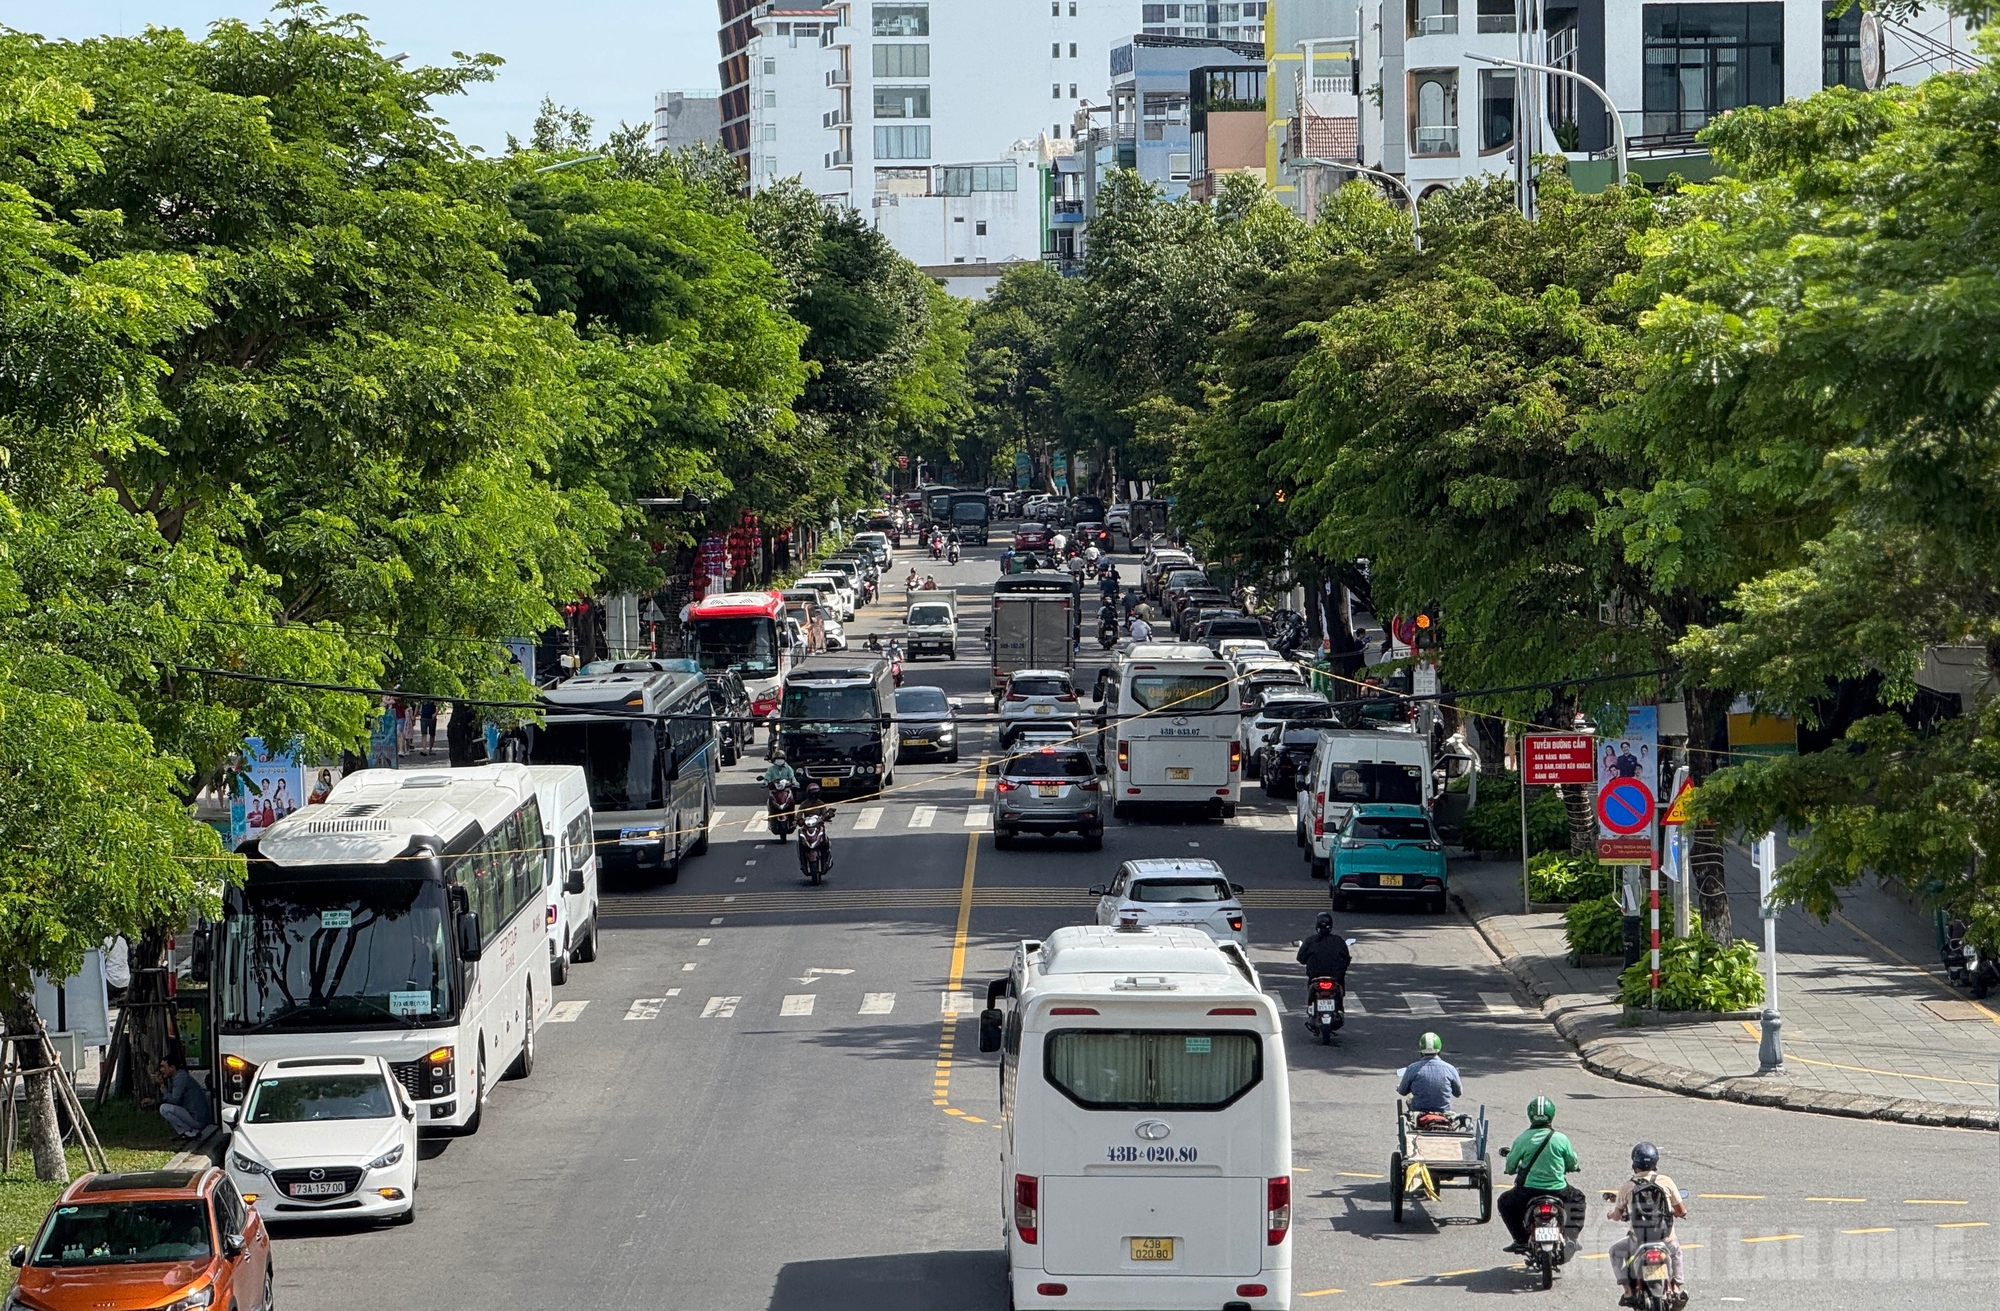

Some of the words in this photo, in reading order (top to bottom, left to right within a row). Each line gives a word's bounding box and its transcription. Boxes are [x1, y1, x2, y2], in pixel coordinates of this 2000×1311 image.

[1533, 737, 1551, 749] TUYẾN
[1552, 738, 1572, 749] ĐƯỜNG
[1573, 736, 1587, 749] CẤM
[1142, 1240, 1161, 1249] 43B
[1135, 1249, 1169, 1259] 020.80
